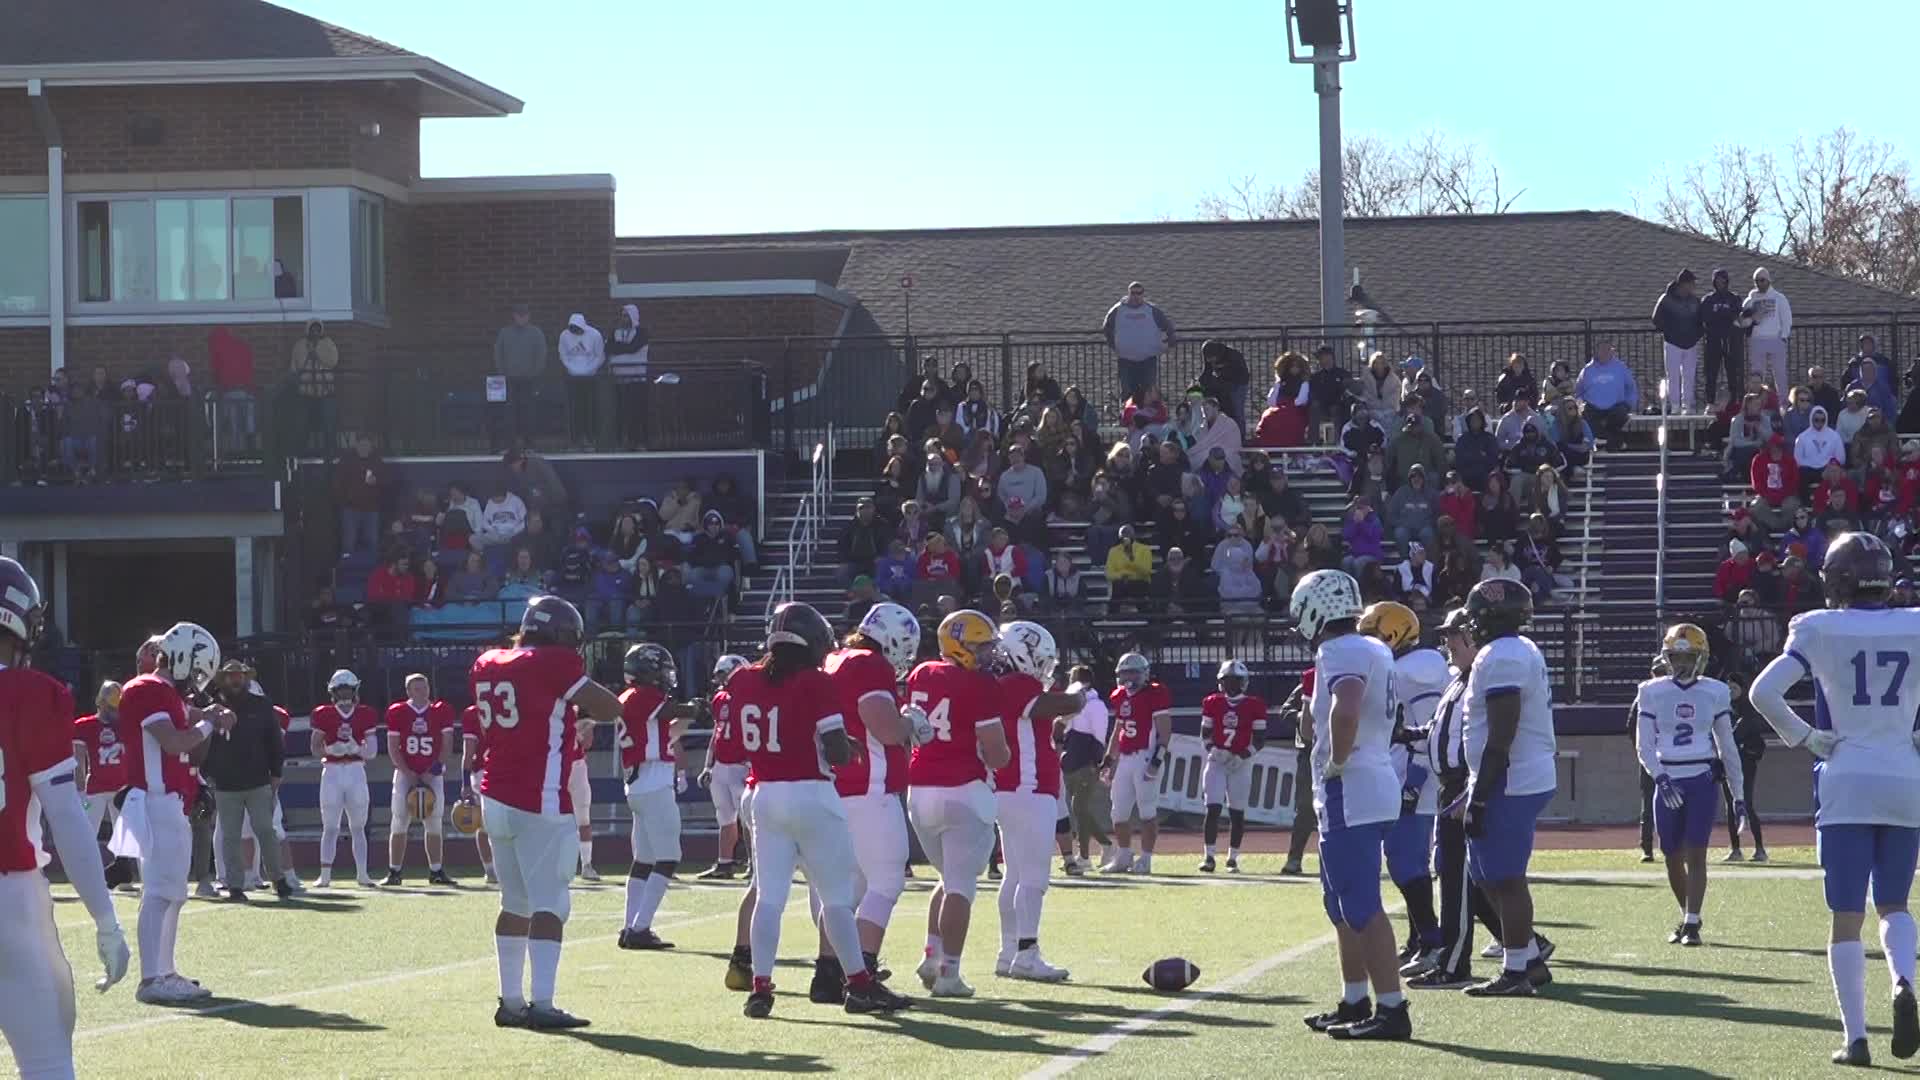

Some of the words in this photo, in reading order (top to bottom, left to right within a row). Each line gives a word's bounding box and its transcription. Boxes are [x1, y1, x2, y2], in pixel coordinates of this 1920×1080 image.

[1850, 650, 1910, 706] 17
[475, 681, 519, 728] 53
[740, 704, 781, 752] 61
[1223, 728, 1236, 747] 7
[1673, 723, 1694, 746] 2
[406, 736, 433, 756] 85
